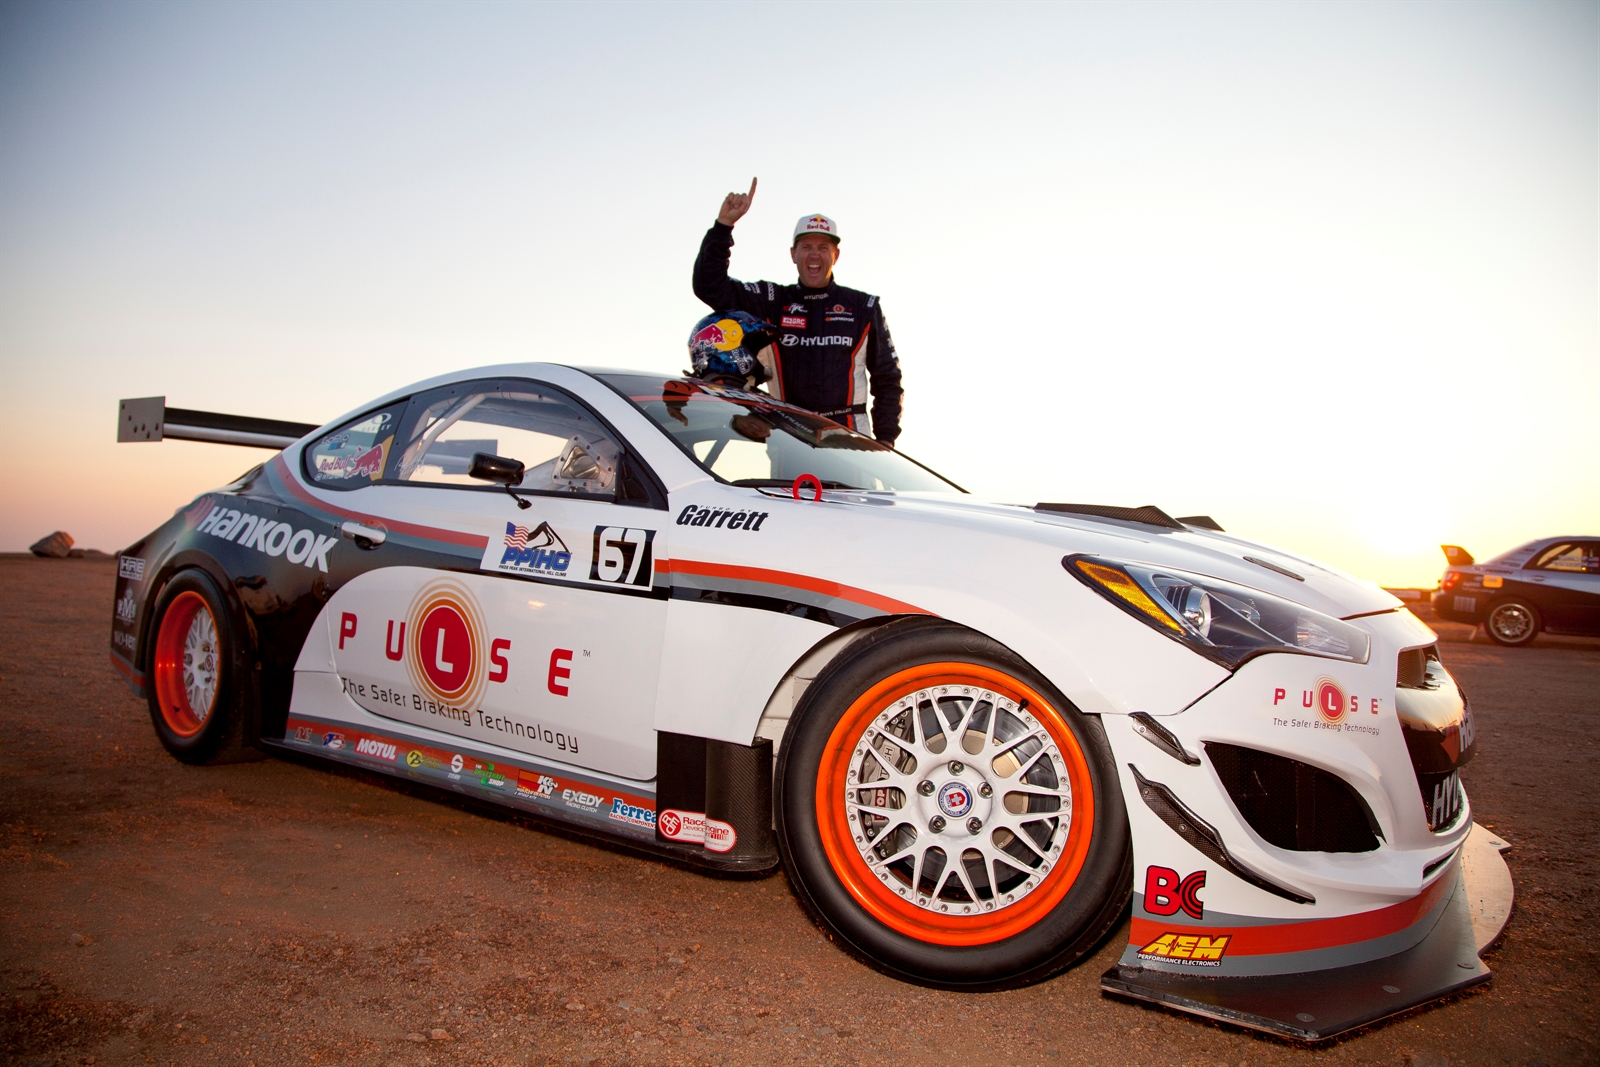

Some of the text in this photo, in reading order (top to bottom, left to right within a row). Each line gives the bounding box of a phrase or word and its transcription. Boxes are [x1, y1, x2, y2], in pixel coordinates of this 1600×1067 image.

[806, 223, 831, 232] Red Bull
[800, 335, 853, 347] HYUNDAI
[676, 504, 769, 532] Garrett
[121, 557, 144, 574] HRE
[500, 545, 572, 572] PPIHC
[597, 526, 647, 585] 67
[338, 611, 574, 697] PULSE
[1273, 687, 1379, 715] PULSE
[341, 677, 579, 754] The Safer Braking Technology
[1273, 717, 1380, 736] The Safer Braking Technology
[356, 738, 397, 760] MOTUL
[562, 788, 605, 808] EXEDY
[565, 801, 581, 809] RACING
[609, 812, 627, 822] RACING
[1143, 865, 1207, 920] BC
[1139, 932, 1231, 960] AEM
[1137, 953, 1221, 967] PERFORMANCE ELECTRONICS
